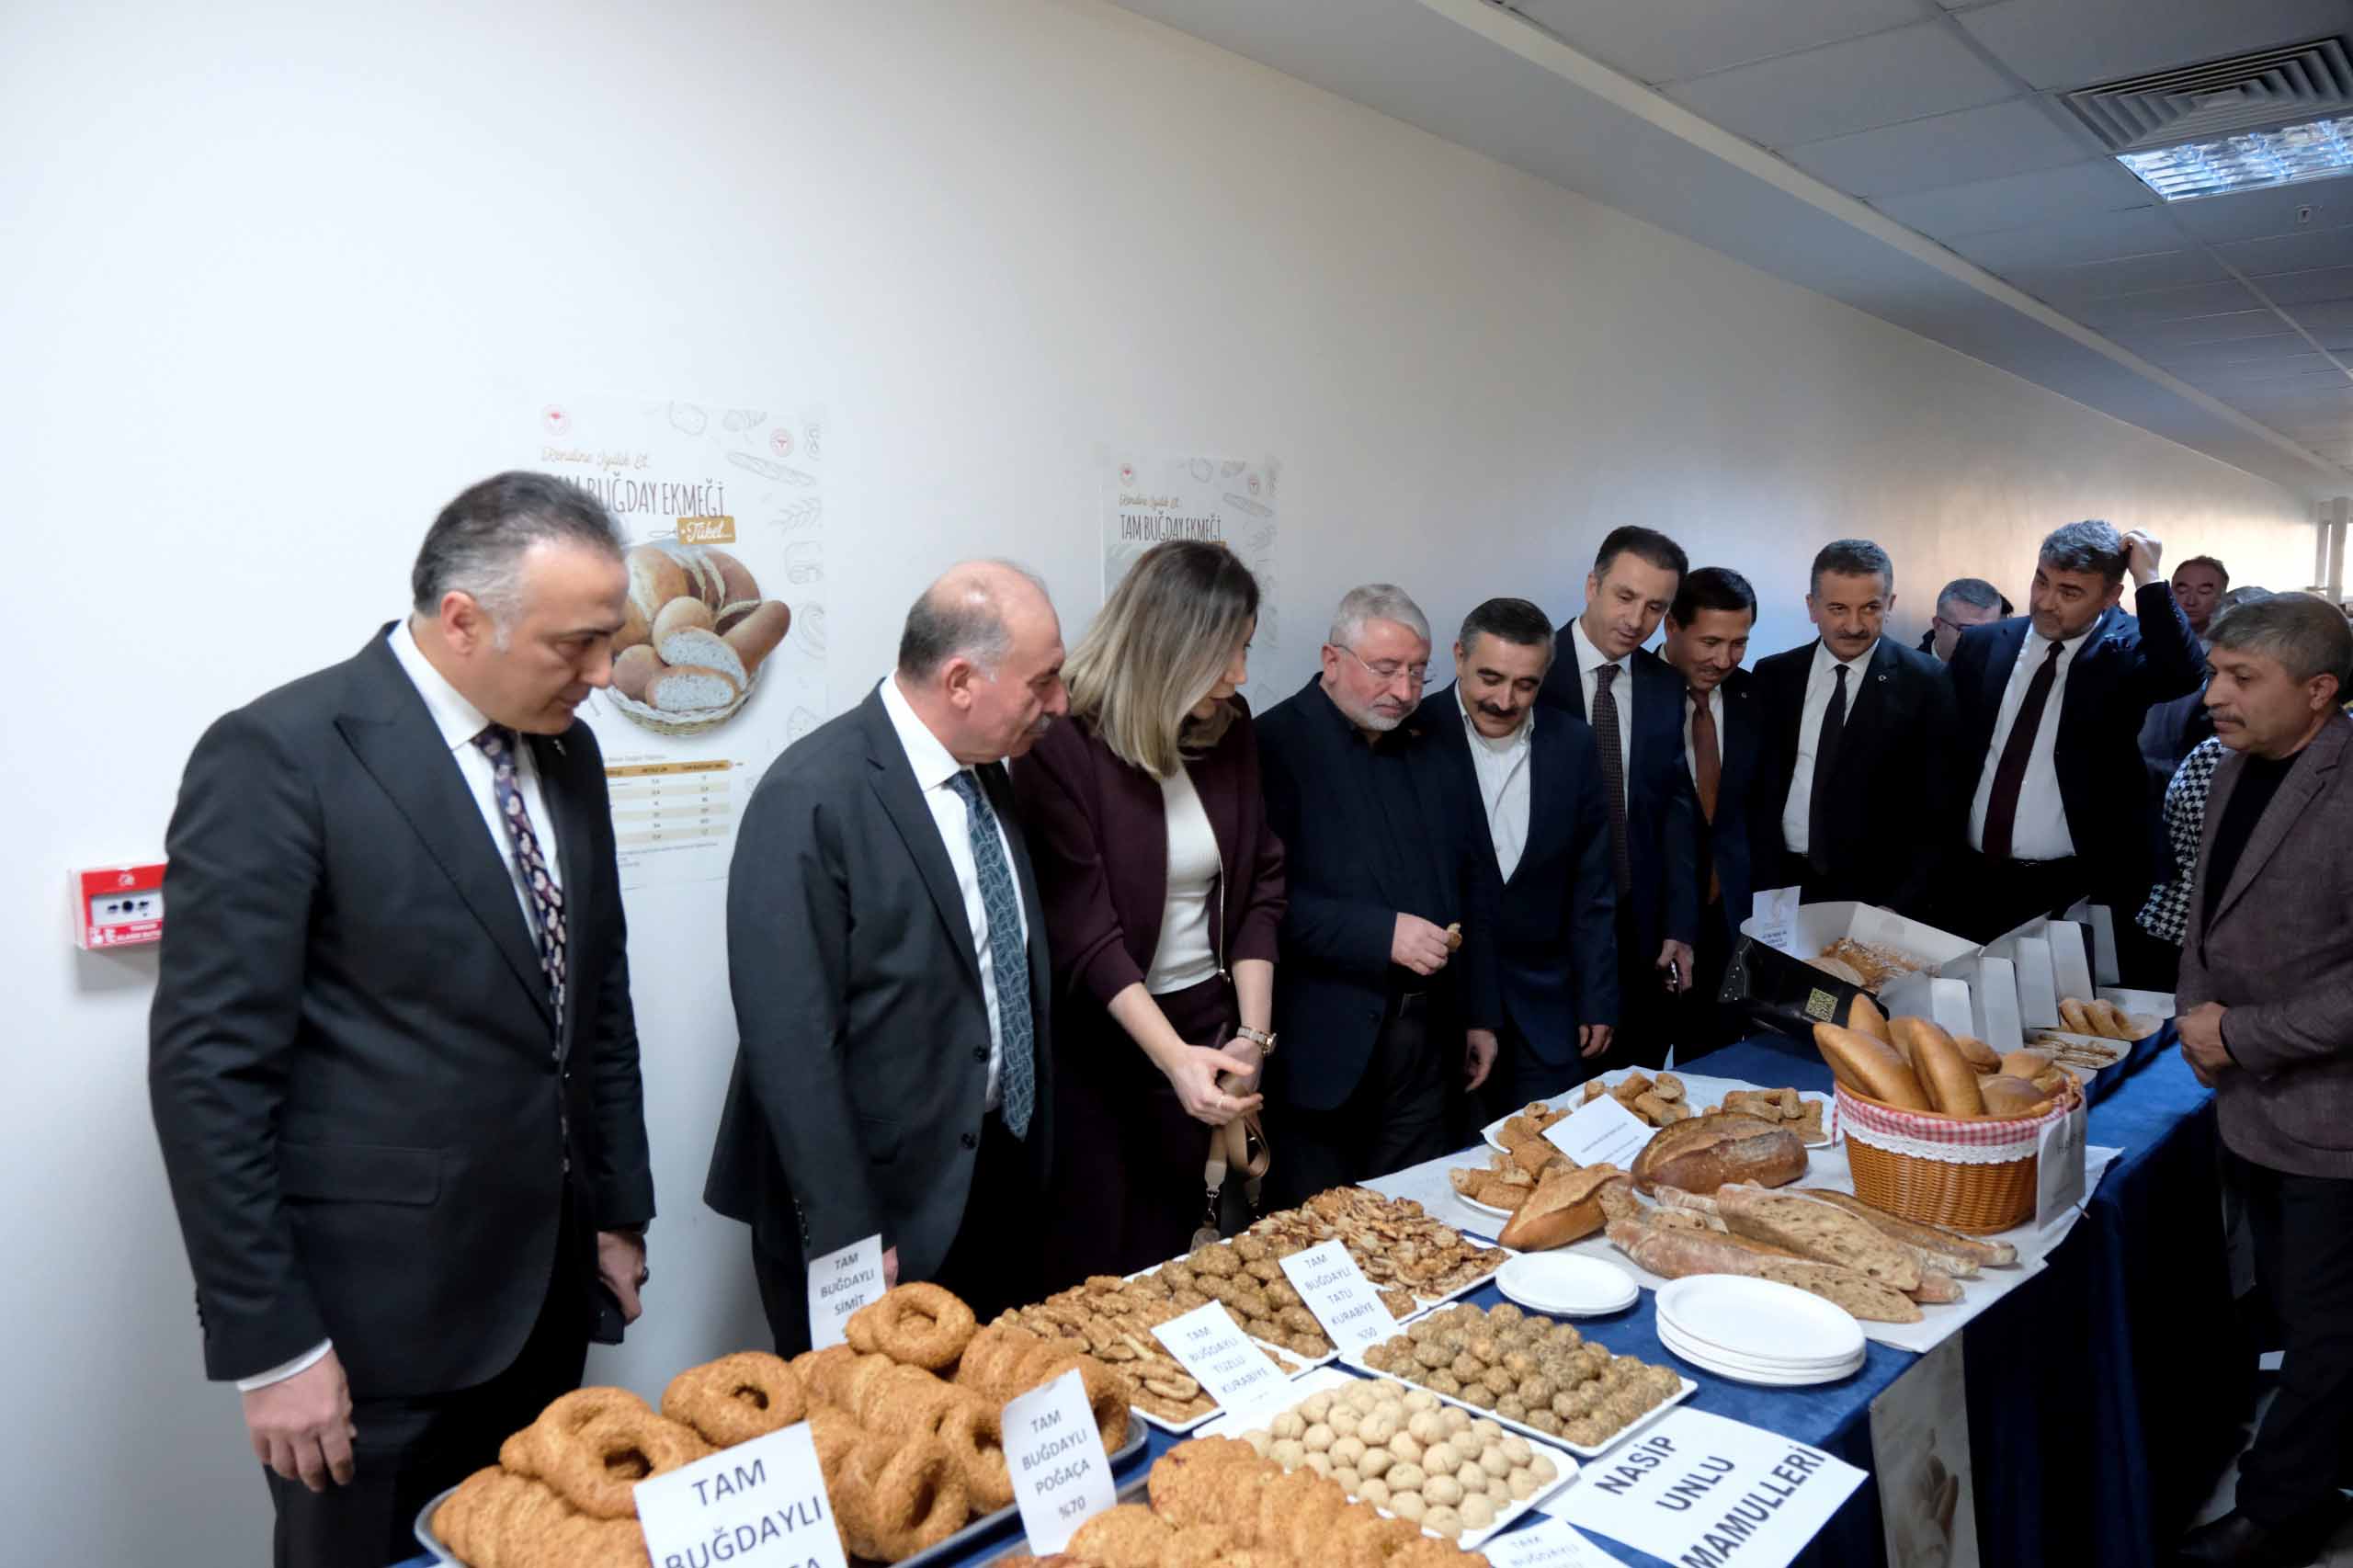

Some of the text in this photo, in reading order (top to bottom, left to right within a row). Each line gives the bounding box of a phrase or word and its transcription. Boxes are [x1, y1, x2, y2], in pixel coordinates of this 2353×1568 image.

[662, 477, 725, 517] EKMEĞİ
[1120, 514, 1142, 541] TAM
[1144, 510, 1186, 542] BUĞDAY
[835, 1253, 858, 1270] TAM
[1304, 1254, 1327, 1269] TAM
[820, 1268, 875, 1298] BUĞDAYLI
[1030, 1410, 1062, 1434] TAM
[1022, 1429, 1088, 1471] BUĞDAYLI
[1594, 1437, 1677, 1495] NASİP
[692, 1459, 767, 1506] TAM
[1035, 1459, 1091, 1496] POĞAÇA
[1655, 1456, 1735, 1511] UNLU
[1059, 1495, 1086, 1521] %70
[1680, 1445, 1826, 1568] MAMULLERİ
[665, 1496, 823, 1568] BUĞDAYLI
